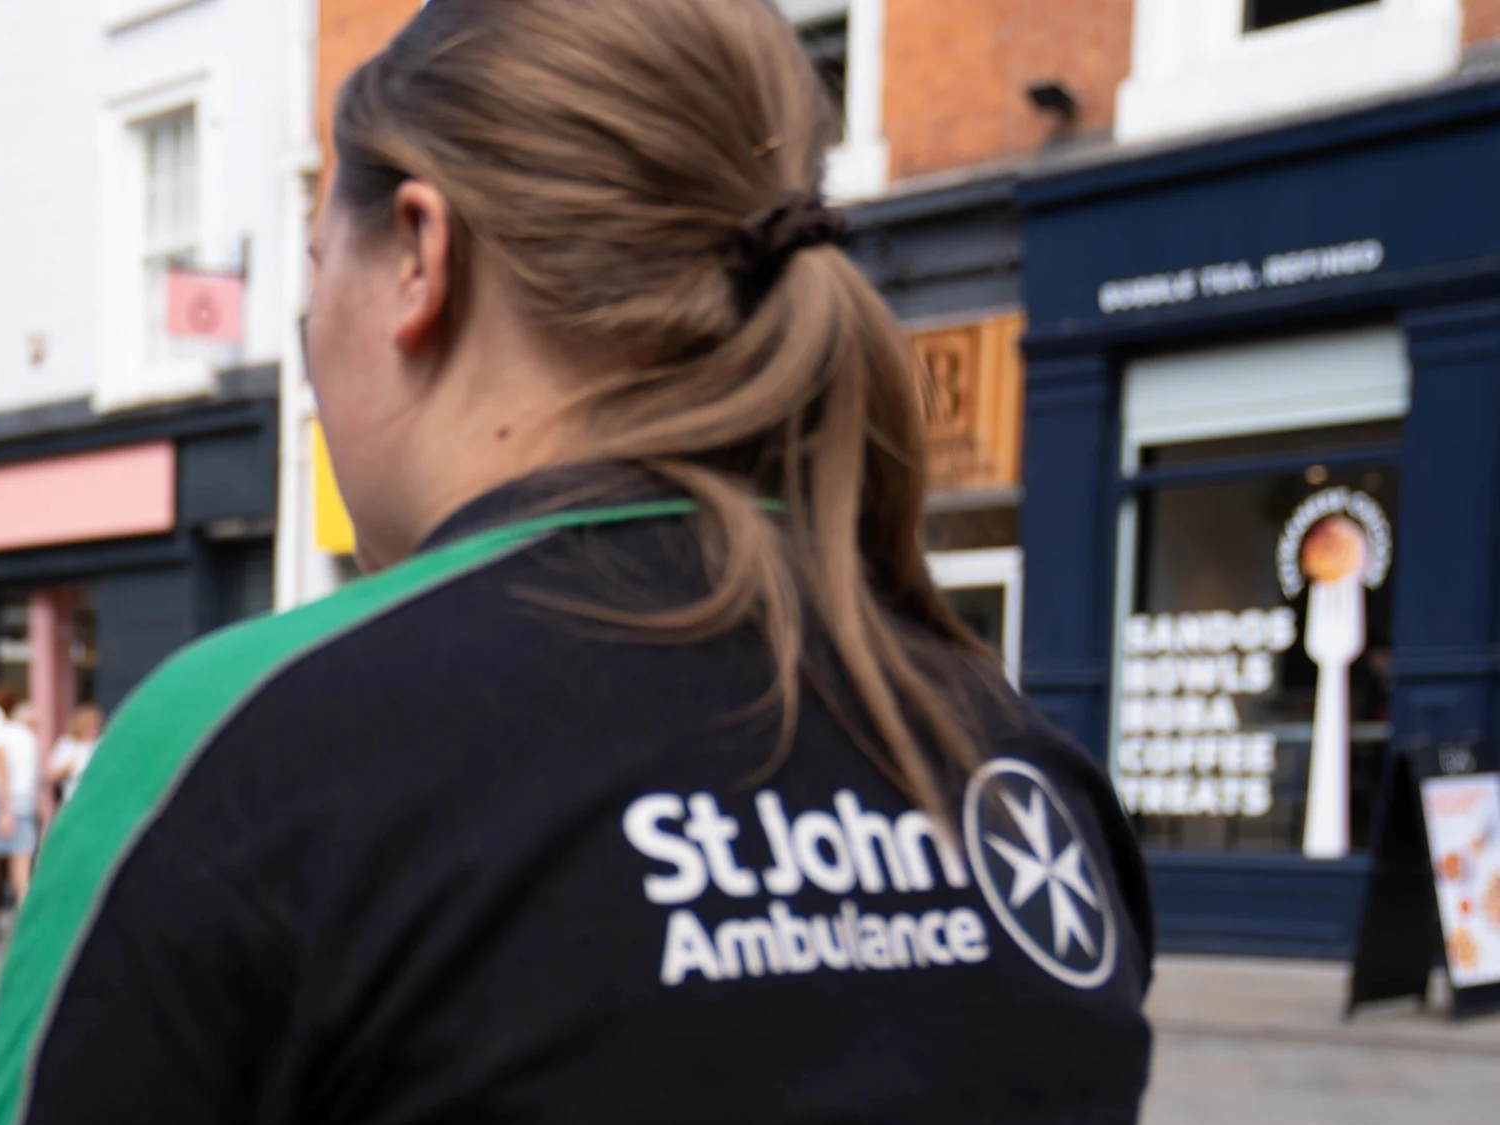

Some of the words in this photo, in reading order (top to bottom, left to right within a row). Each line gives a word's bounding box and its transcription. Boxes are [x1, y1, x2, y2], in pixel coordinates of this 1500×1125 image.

[1123, 607, 1296, 652] SANDOS
[1121, 652, 1273, 694] BOWLS
[1119, 695, 1240, 733] BOBA
[1117, 733, 1276, 773] COFFEE
[1118, 775, 1272, 816] TREATS
[622, 792, 760, 904] St
[754, 788, 971, 896] John
[660, 896, 991, 986] Ambulance
